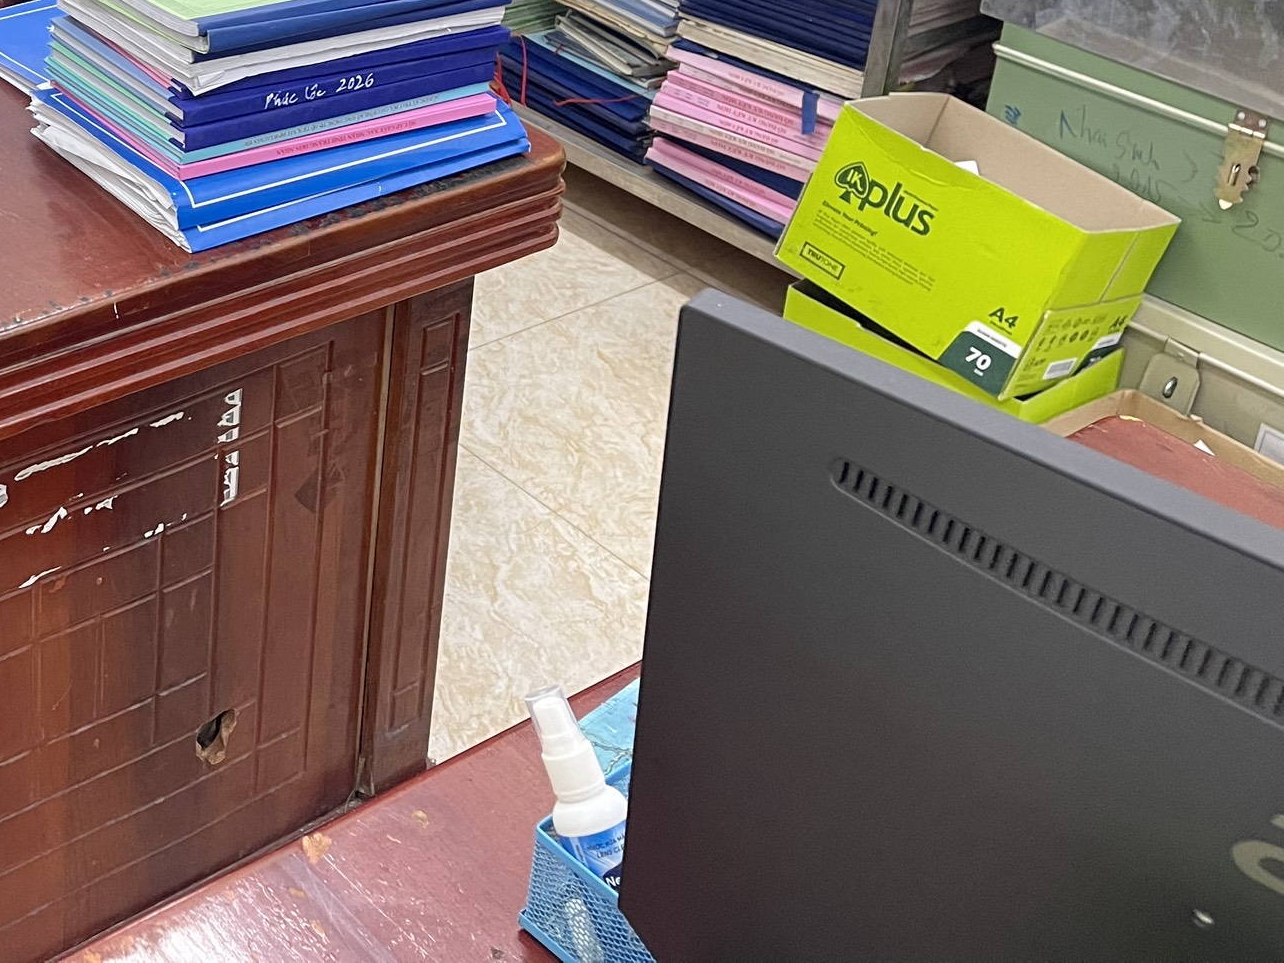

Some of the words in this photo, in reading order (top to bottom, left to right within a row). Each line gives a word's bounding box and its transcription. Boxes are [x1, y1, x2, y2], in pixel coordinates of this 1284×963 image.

[335, 73, 376, 94] 2026
[857, 178, 936, 237] plus
[806, 247, 840, 274] TRUTONE
[988, 306, 1019, 329] A4
[965, 346, 993, 371] 70
[605, 875, 621, 887] Ne
